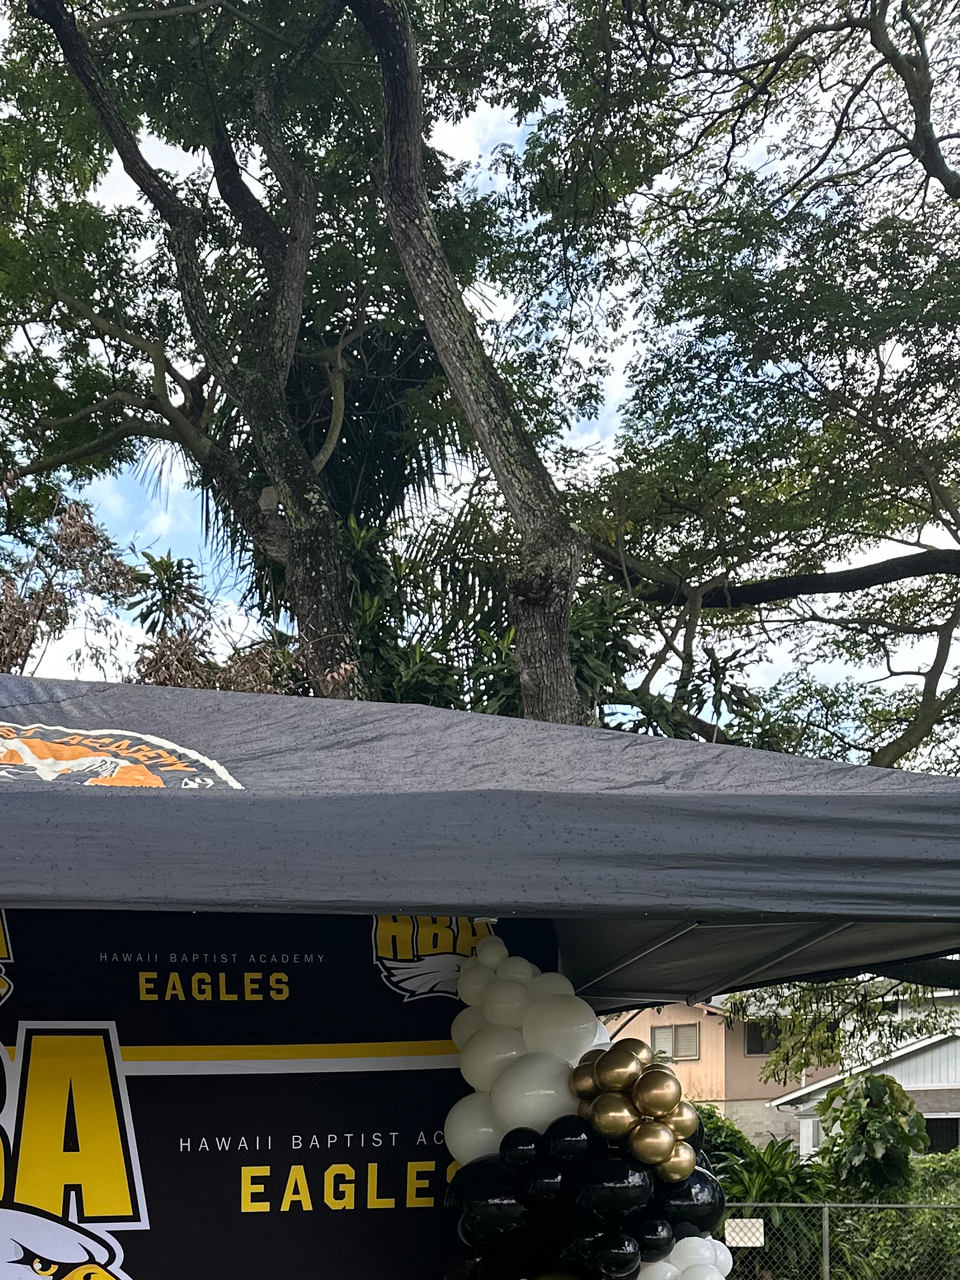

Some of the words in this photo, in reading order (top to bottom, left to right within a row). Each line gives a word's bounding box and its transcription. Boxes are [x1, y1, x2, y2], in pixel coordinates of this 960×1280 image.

[99, 952, 158, 963] HAWAII
[169, 953, 238, 964] BAPTIST
[248, 953, 324, 964] ACADEMY
[138, 971, 289, 1001] EAGLES
[179, 1135, 272, 1152] HAWAII
[292, 1132, 399, 1149] BAPTIST
[240, 1160, 459, 1213] EAGLE
